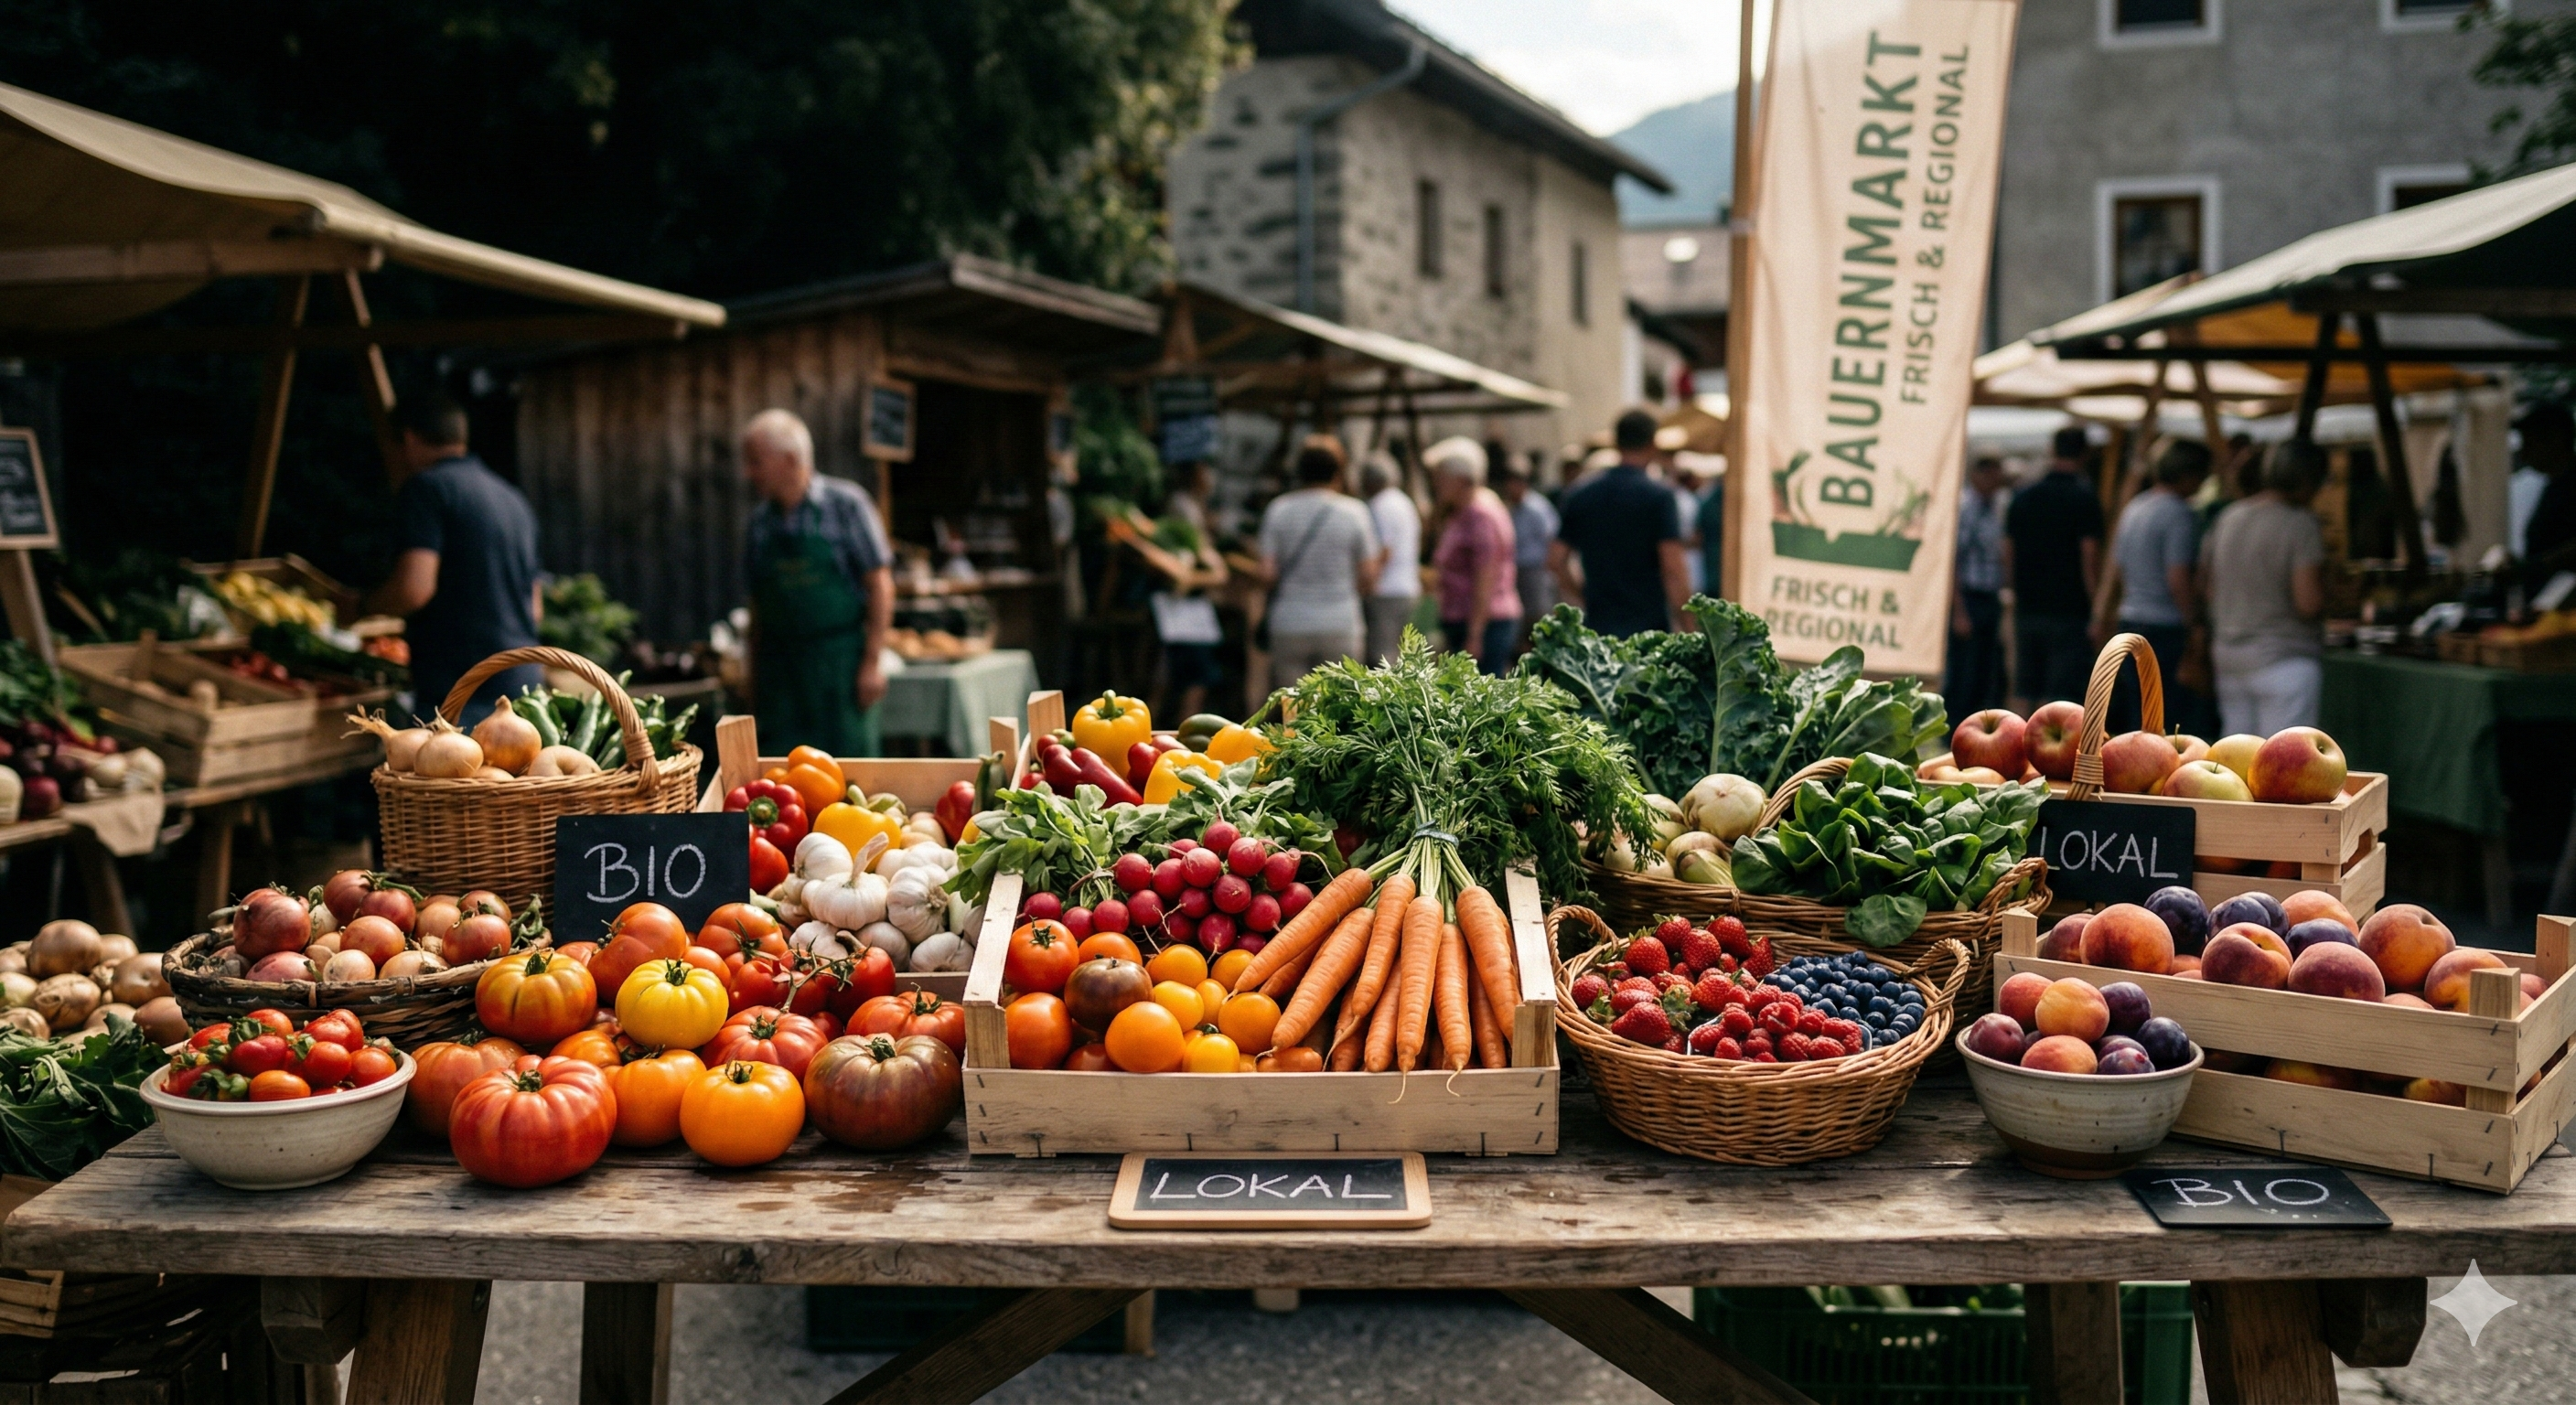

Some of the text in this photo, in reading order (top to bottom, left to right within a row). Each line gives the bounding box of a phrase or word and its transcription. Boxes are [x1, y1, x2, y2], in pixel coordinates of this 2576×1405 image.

[1900, 45, 1970, 405] FRISCH & REGIONAL
[1819, 30, 1924, 509] BAUERNMARKT
[1771, 575, 1899, 615] FRISCH &
[1765, 607, 1903, 650] REGIONAL
[584, 842, 706, 903] BIO
[2039, 826, 2179, 879] LOKAL
[1150, 1172, 1392, 1199] LOKAL
[2151, 1177, 2330, 1207] BIO
